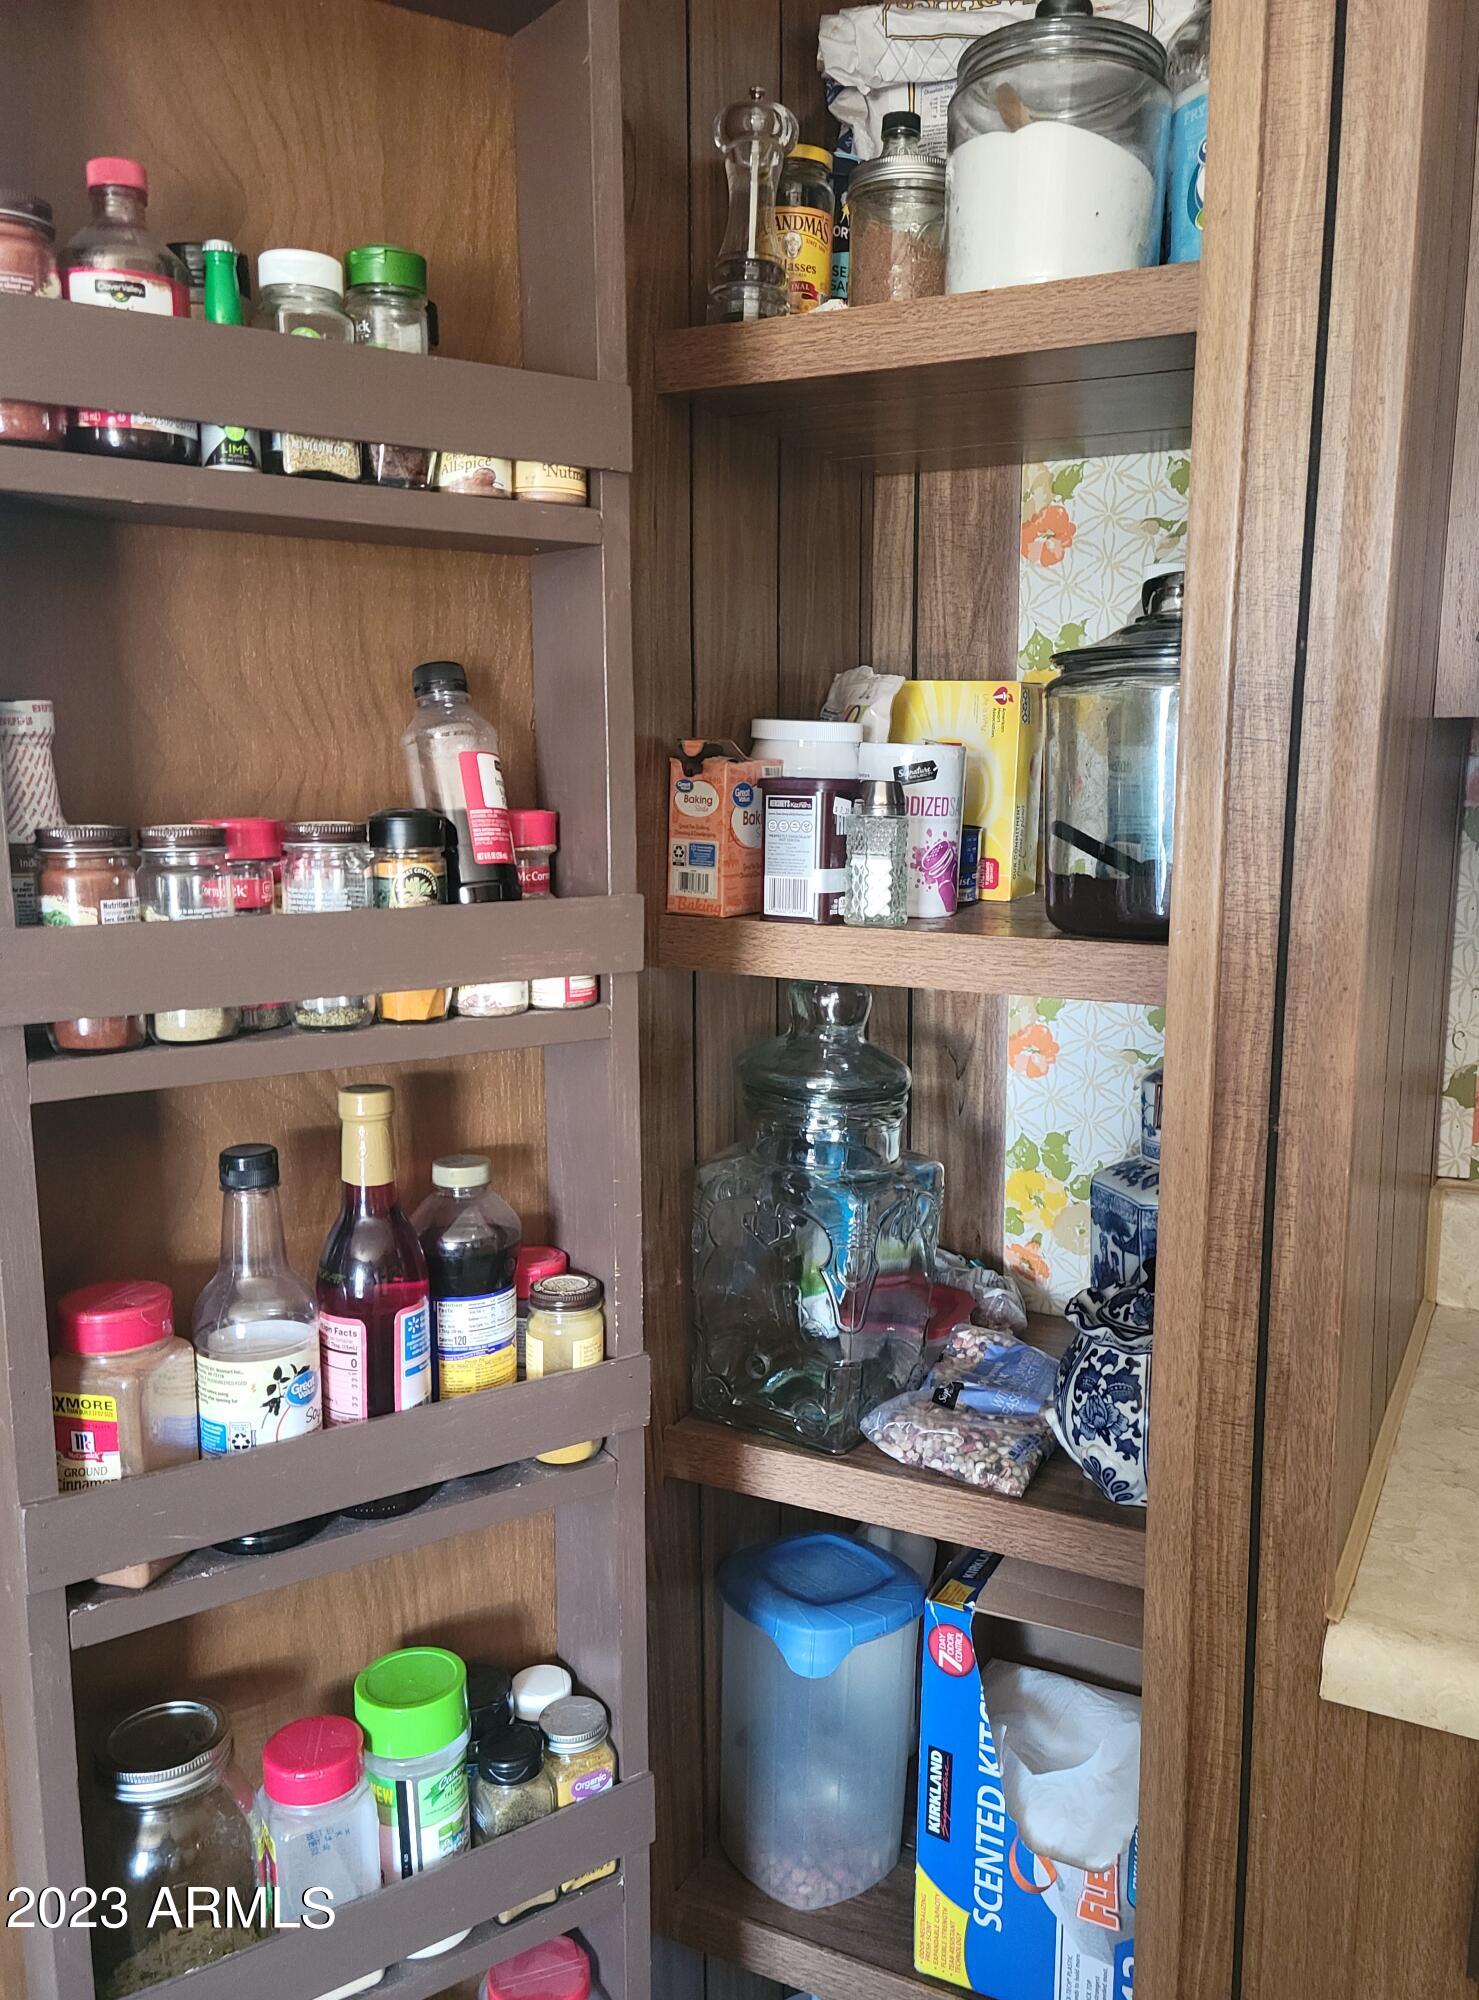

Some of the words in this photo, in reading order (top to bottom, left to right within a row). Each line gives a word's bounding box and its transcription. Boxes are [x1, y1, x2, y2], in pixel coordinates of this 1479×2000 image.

[784, 259, 817, 275] lasses
[221, 442, 249, 456] LIME
[441, 457, 492, 475] Allspice
[543, 463, 584, 481] Nutm
[684, 794, 713, 807] Baking
[904, 795, 949, 817] DIZED
[743, 810, 761, 826] Bak
[1013, 805, 1021, 860] COMMITMENT
[518, 870, 550, 882] McCor
[334, 1326, 358, 1338] Facts
[454, 1335, 467, 1346] 120
[350, 1358, 358, 1369] 0
[290, 1376, 315, 1395] Great
[66, 1397, 114, 1412] MORE
[64, 1466, 108, 1478] GROUND
[939, 1632, 947, 1650] DAY
[946, 1632, 955, 1656] ODOR
[954, 1632, 963, 1663] CONTROL
[938, 1649, 963, 1672] 7
[574, 1772, 607, 1792] Organic
[927, 1749, 944, 1835] KIRKLAND
[973, 1784, 1007, 1933] SCENTED
